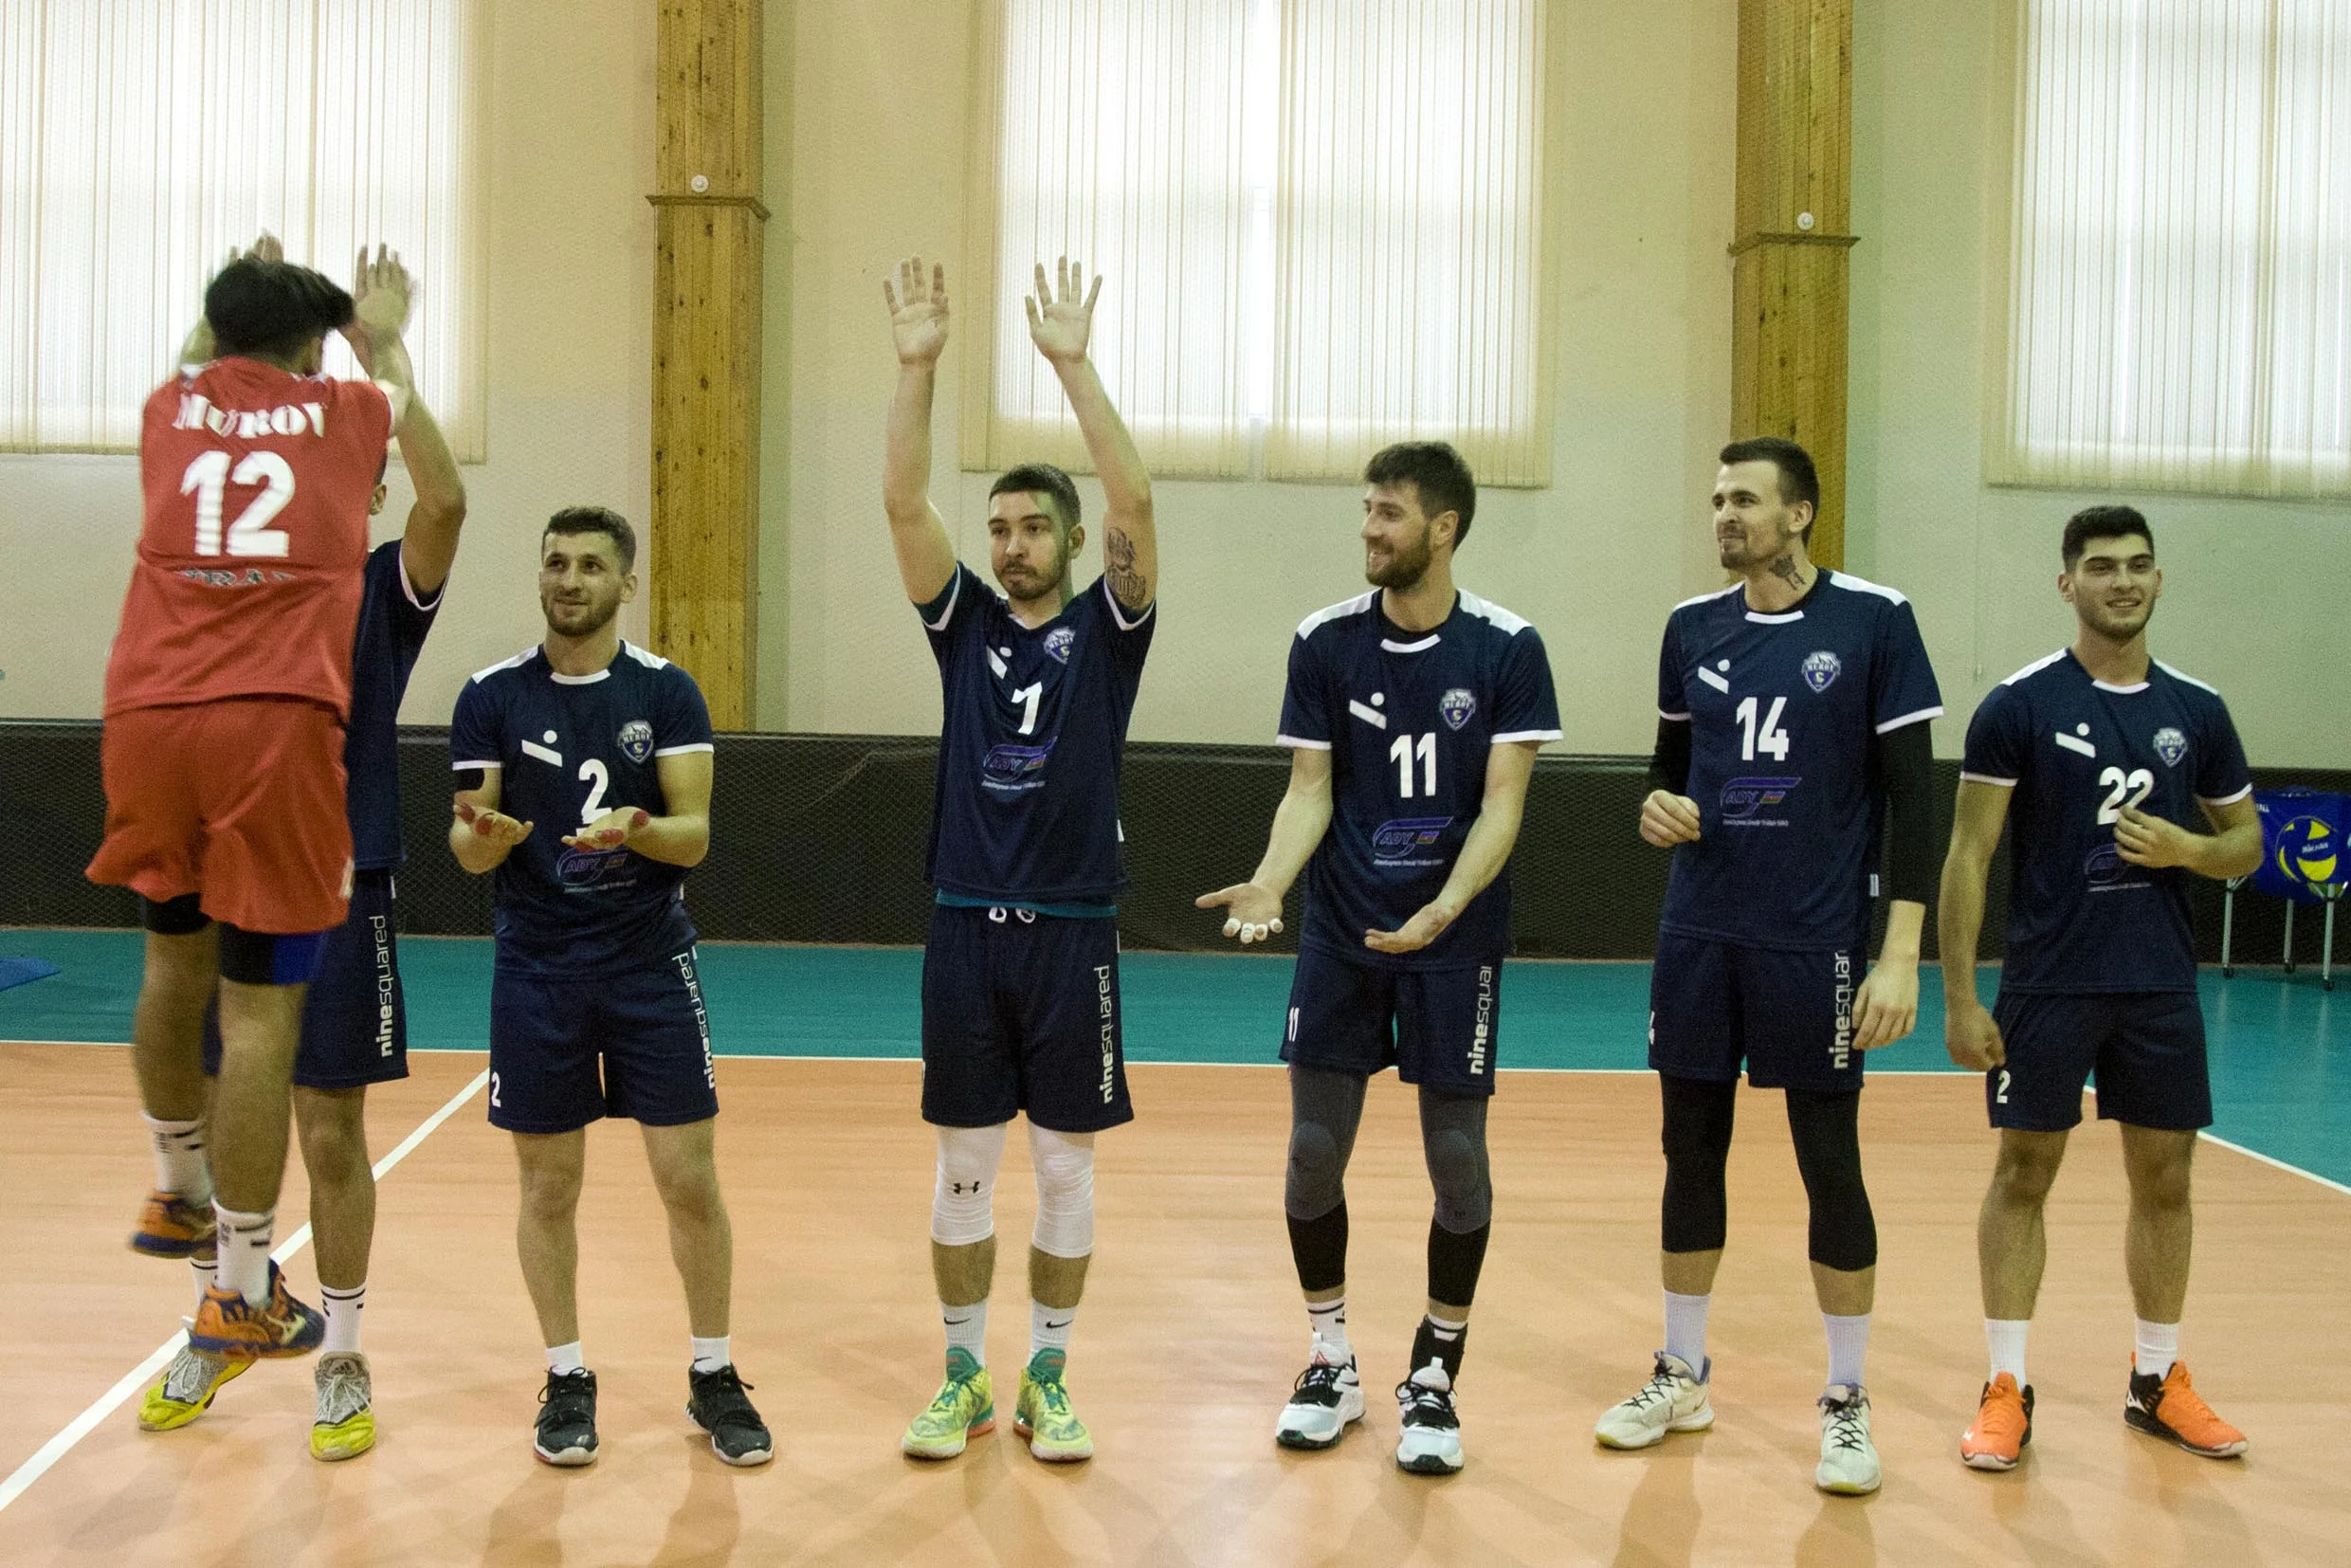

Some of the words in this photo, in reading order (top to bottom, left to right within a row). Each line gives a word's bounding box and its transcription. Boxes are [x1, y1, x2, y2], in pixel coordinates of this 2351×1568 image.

[180, 449, 296, 557] 12
[1011, 681, 1043, 736] 1
[1736, 696, 1790, 762] 14
[578, 758, 612, 825] 2
[1390, 732, 1437, 798] 11
[2097, 766, 2155, 826] 22
[368, 915, 394, 1058] ninesquared
[671, 952, 716, 1089] ninesquared
[1093, 964, 1115, 1103] ninesquared
[491, 1071, 501, 1107] 2
[1996, 1069, 2012, 1104] 2
